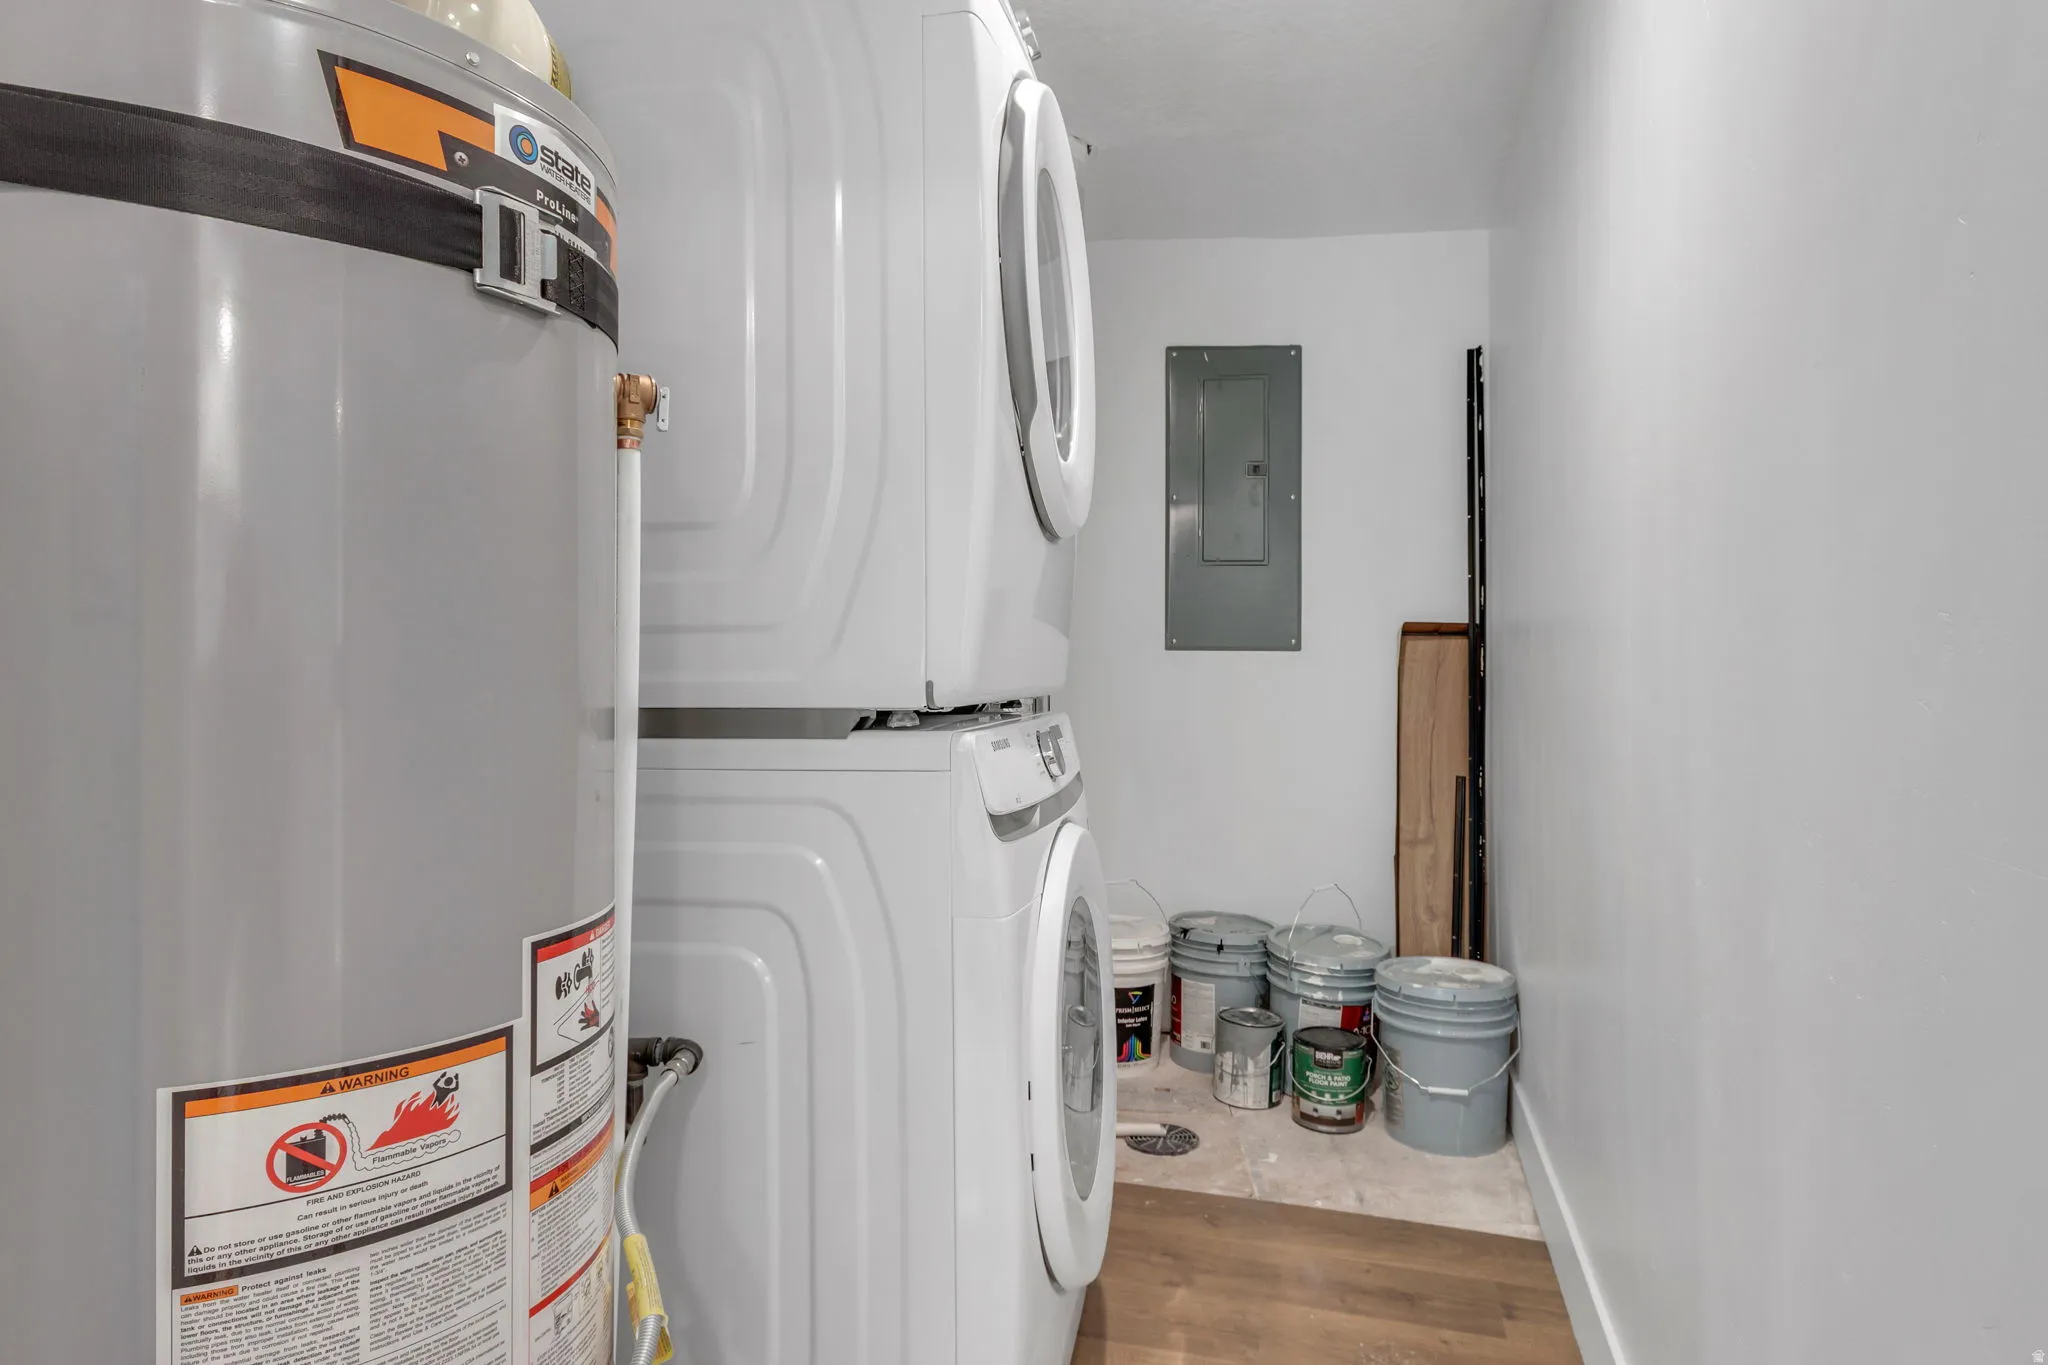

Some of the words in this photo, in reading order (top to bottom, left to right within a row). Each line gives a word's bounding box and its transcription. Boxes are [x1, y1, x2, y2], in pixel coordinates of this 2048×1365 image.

[540, 145, 591, 196] state
[540, 162, 565, 186] WATER
[565, 178, 592, 205] HEATERS
[536, 189, 577, 223] ProLine
[338, 1067, 409, 1091] WARNING
[1305, 1070, 1326, 1081] PORCH
[1309, 1077, 1328, 1086] FLOOR
[372, 1146, 417, 1164] Flammable
[420, 1138, 447, 1152] Vapors
[286, 1170, 325, 1183] FLAMMABLES
[306, 1196, 325, 1205] FIRE
[327, 1192, 344, 1201] AND
[346, 1180, 389, 1196] EXPLOSION
[391, 1170, 421, 1184] HAZARD
[297, 1213, 313, 1221] Can
[315, 1205, 338, 1217] result
[349, 1197, 376, 1209] serious
[410, 1179, 428, 1191] death
[188, 1256, 203, 1264] this
[217, 1252, 232, 1260] any
[234, 1247, 256, 1256] other
[259, 1239, 300, 1252] appliance.
[302, 1229, 334, 1242] Storage
[335, 1225, 343, 1233] of
[355, 1219, 369, 1228] use
[371, 1215, 379, 1223] of
[380, 1207, 410, 1222] gasoline
[420, 1197, 438, 1207] other
[204, 1245, 215, 1253] Do
[218, 1242, 231, 1251] not
[234, 1239, 255, 1248] store
[269, 1233, 283, 1241] use
[285, 1225, 319, 1239] gasoline
[332, 1216, 353, 1226] other
[354, 1204, 392, 1220] flammable
[394, 1196, 417, 1208] vapors
[419, 1190, 431, 1200] and
[187, 1263, 216, 1274] liquids
[229, 1258, 242, 1266] the
[244, 1251, 274, 1263] vicinity
[276, 1248, 285, 1256] of
[286, 1245, 302, 1254] this
[314, 1239, 329, 1247] any
[331, 1233, 350, 1243] other
[353, 1221, 388, 1237] appliance
[390, 1217, 402, 1225] can
[404, 1208, 424, 1221] result
[426, 1206, 432, 1214] in
[193, 1288, 234, 1301] WARNING
[241, 1280, 270, 1292] Protect
[274, 1272, 303, 1286] against
[307, 1267, 327, 1277] leaks
